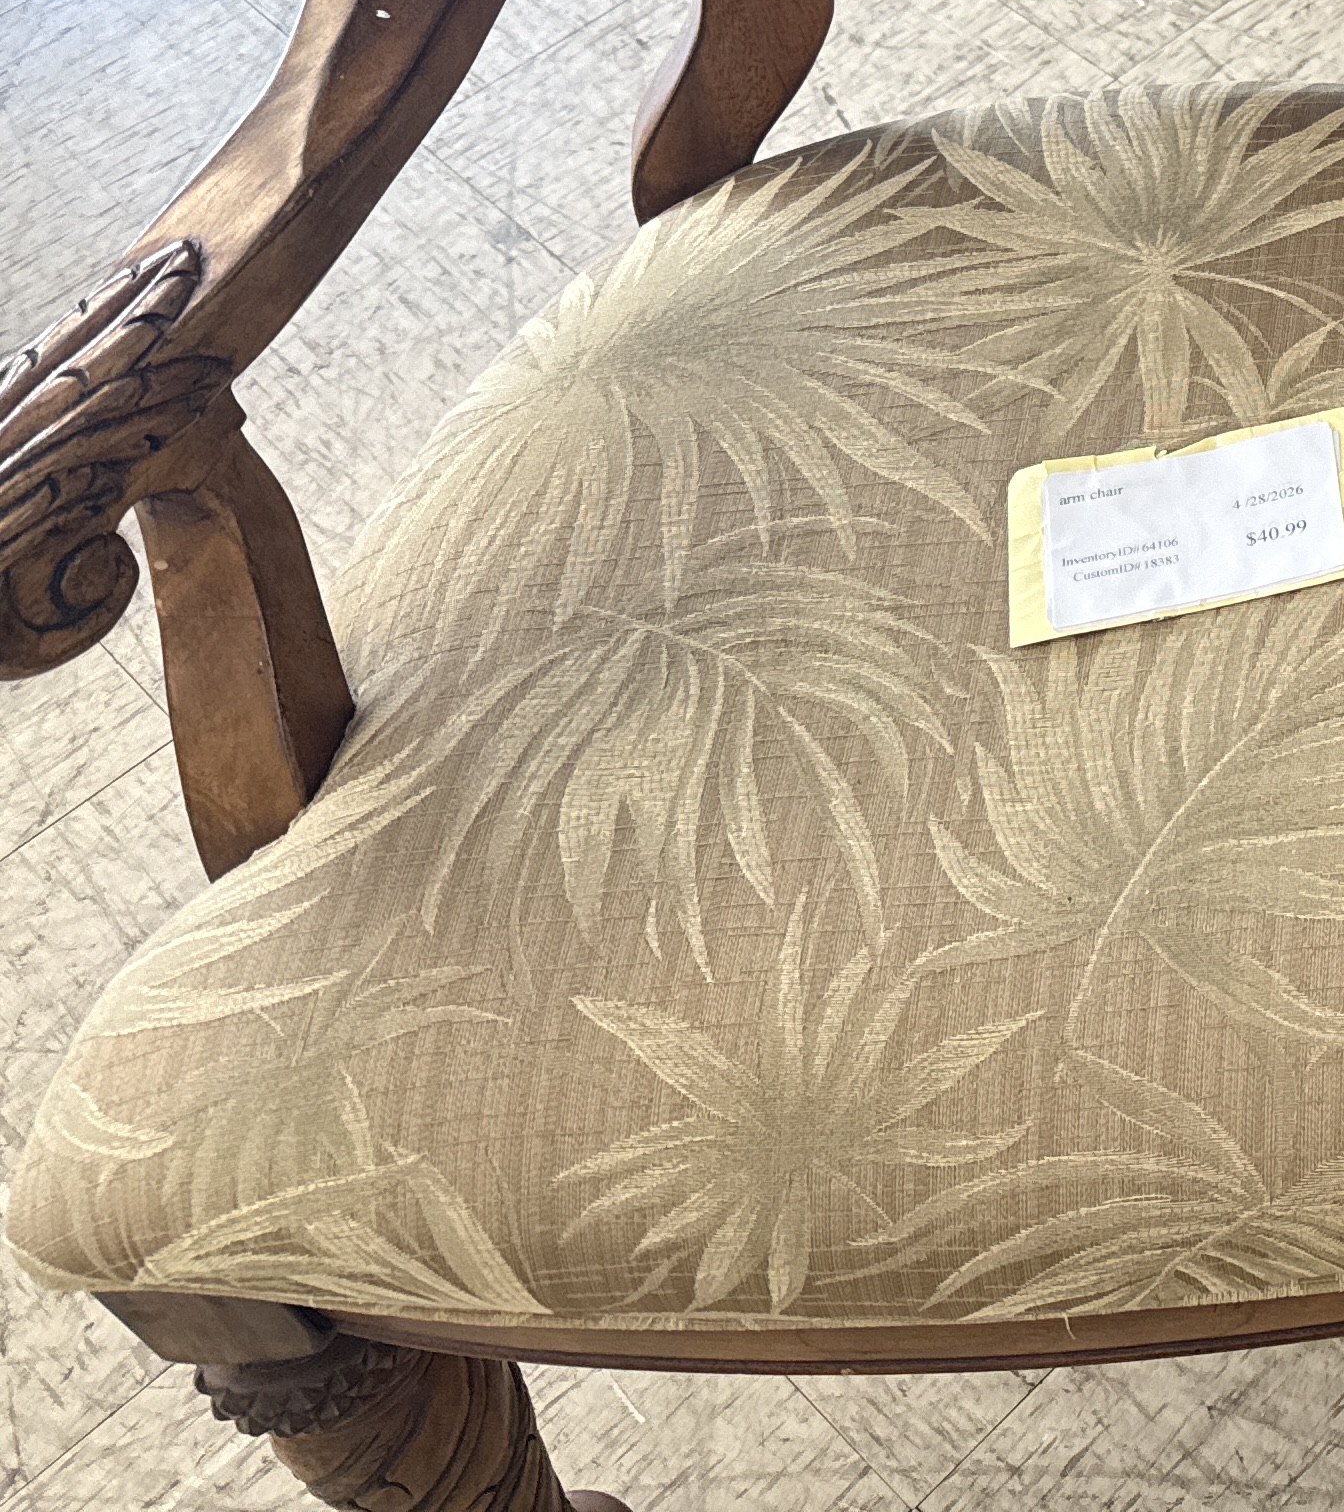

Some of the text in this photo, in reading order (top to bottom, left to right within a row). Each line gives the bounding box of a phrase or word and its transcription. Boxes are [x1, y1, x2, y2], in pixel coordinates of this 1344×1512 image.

[1059, 486, 1124, 506] arm chair
[1245, 519, 1307, 547] $40.99
